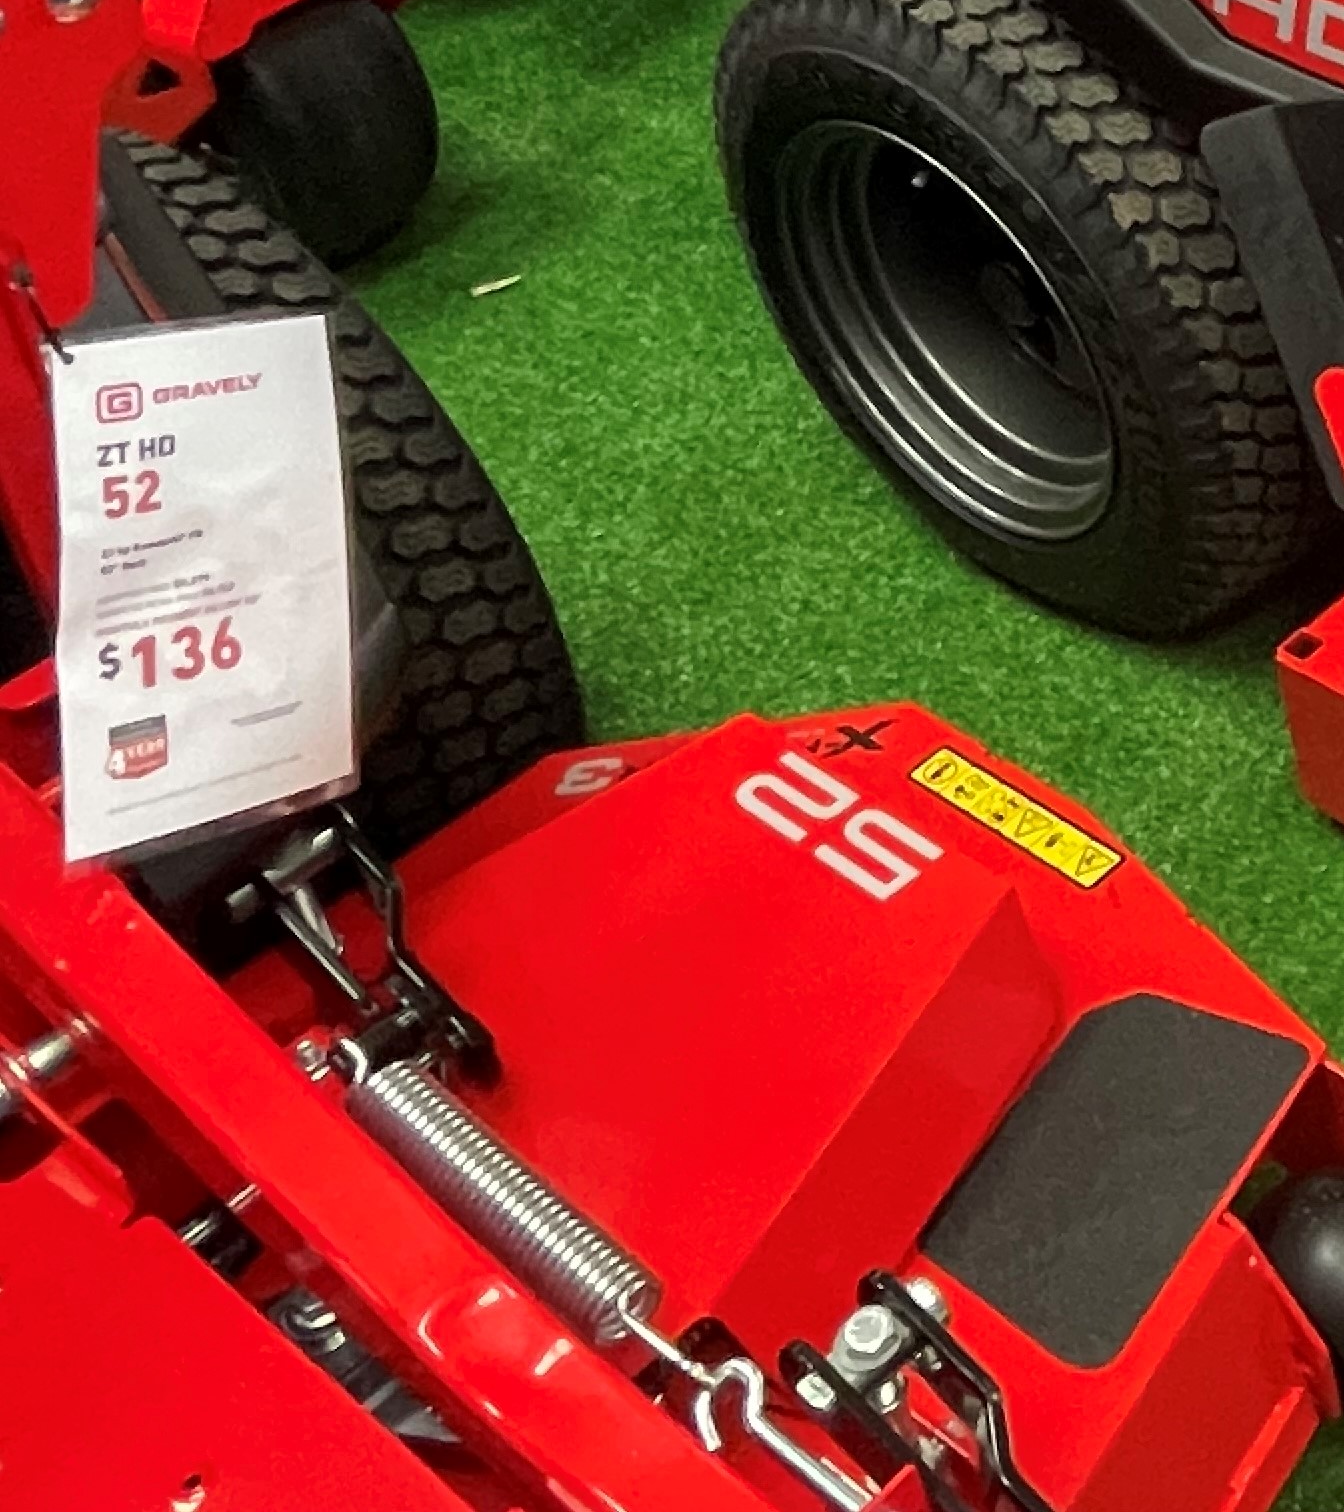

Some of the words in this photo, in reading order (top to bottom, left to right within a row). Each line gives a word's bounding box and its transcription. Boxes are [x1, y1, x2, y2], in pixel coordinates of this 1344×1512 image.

[152, 372, 263, 405] GRAVELY
[97, 440, 131, 467] ZT
[138, 434, 176, 462] HD
[102, 470, 162, 520] 52
[98, 615, 243, 688] $136
[735, 750, 945, 902] 52
